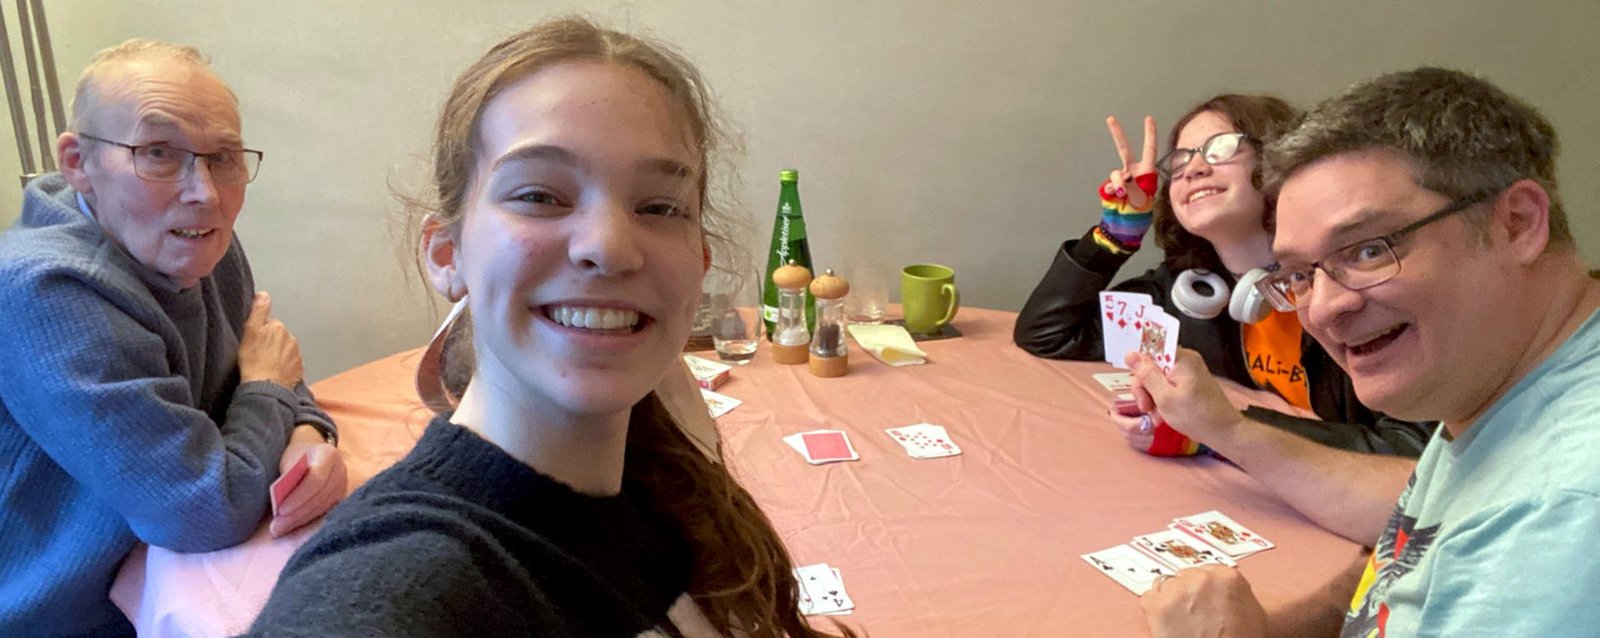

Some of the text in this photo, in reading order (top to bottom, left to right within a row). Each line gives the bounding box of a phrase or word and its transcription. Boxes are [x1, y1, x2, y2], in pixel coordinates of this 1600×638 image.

[776, 214, 790, 268] Appletiser
[1105, 295, 1114, 310] 5
[1117, 301, 1127, 315] 7
[1135, 304, 1145, 318] J
[833, 598, 844, 607] 4
